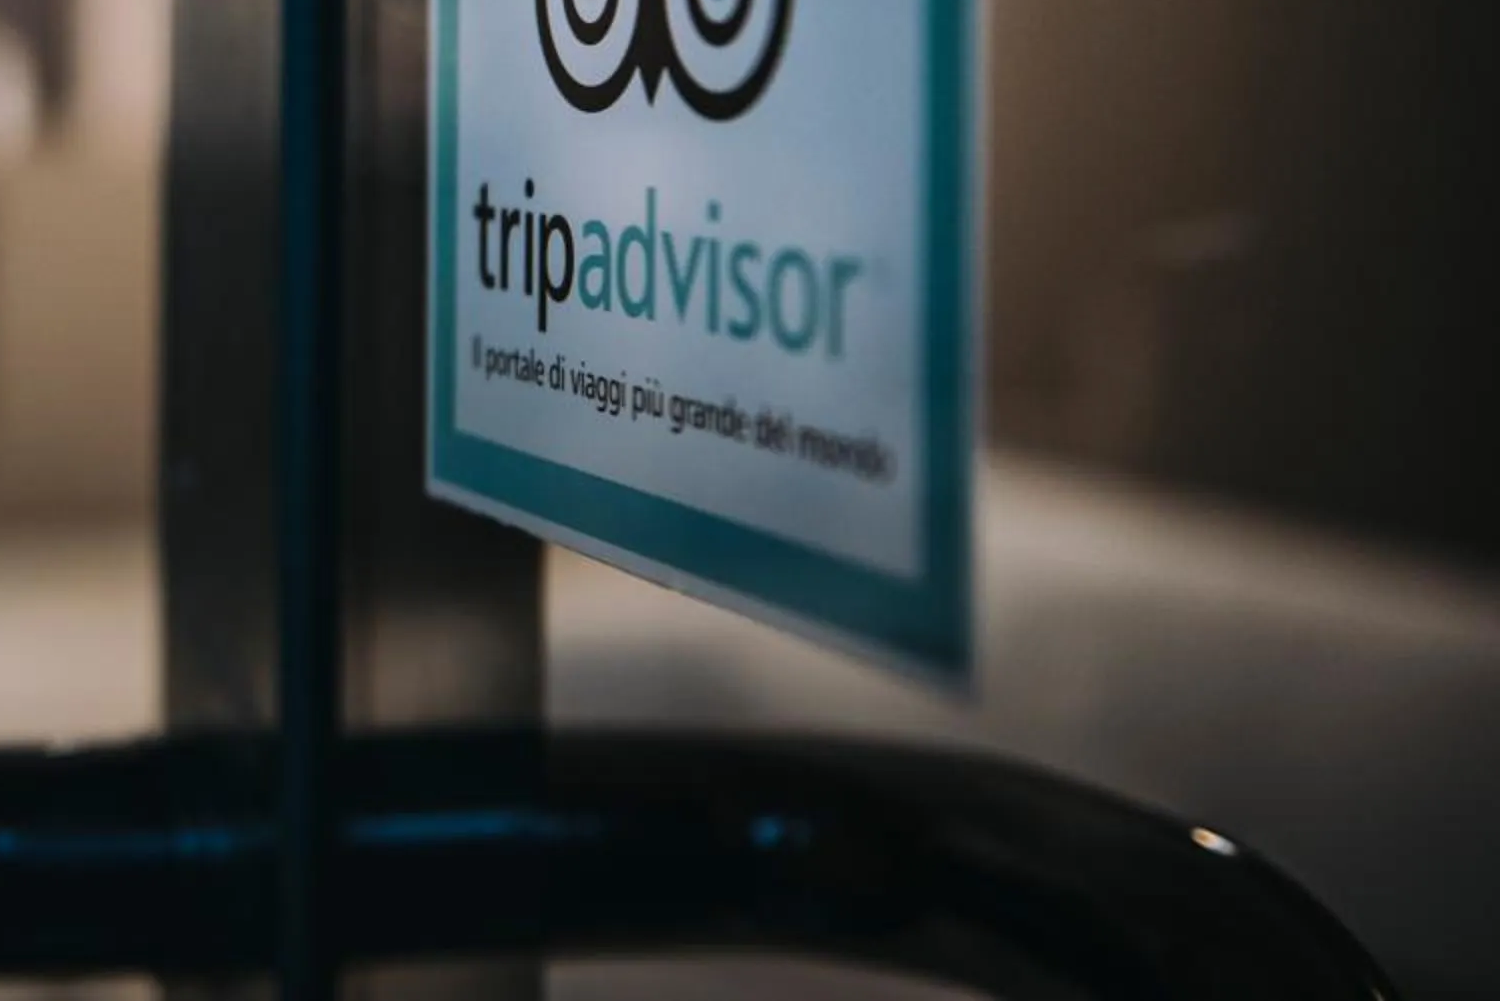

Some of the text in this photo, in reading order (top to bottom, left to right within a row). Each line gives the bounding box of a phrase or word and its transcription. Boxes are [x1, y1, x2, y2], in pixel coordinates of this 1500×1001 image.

[473, 177, 862, 360] tripadvisor
[485, 348, 545, 387] portale
[550, 353, 566, 392] di
[570, 361, 627, 416] viaggi
[631, 377, 665, 422] più
[669, 394, 748, 444] grande
